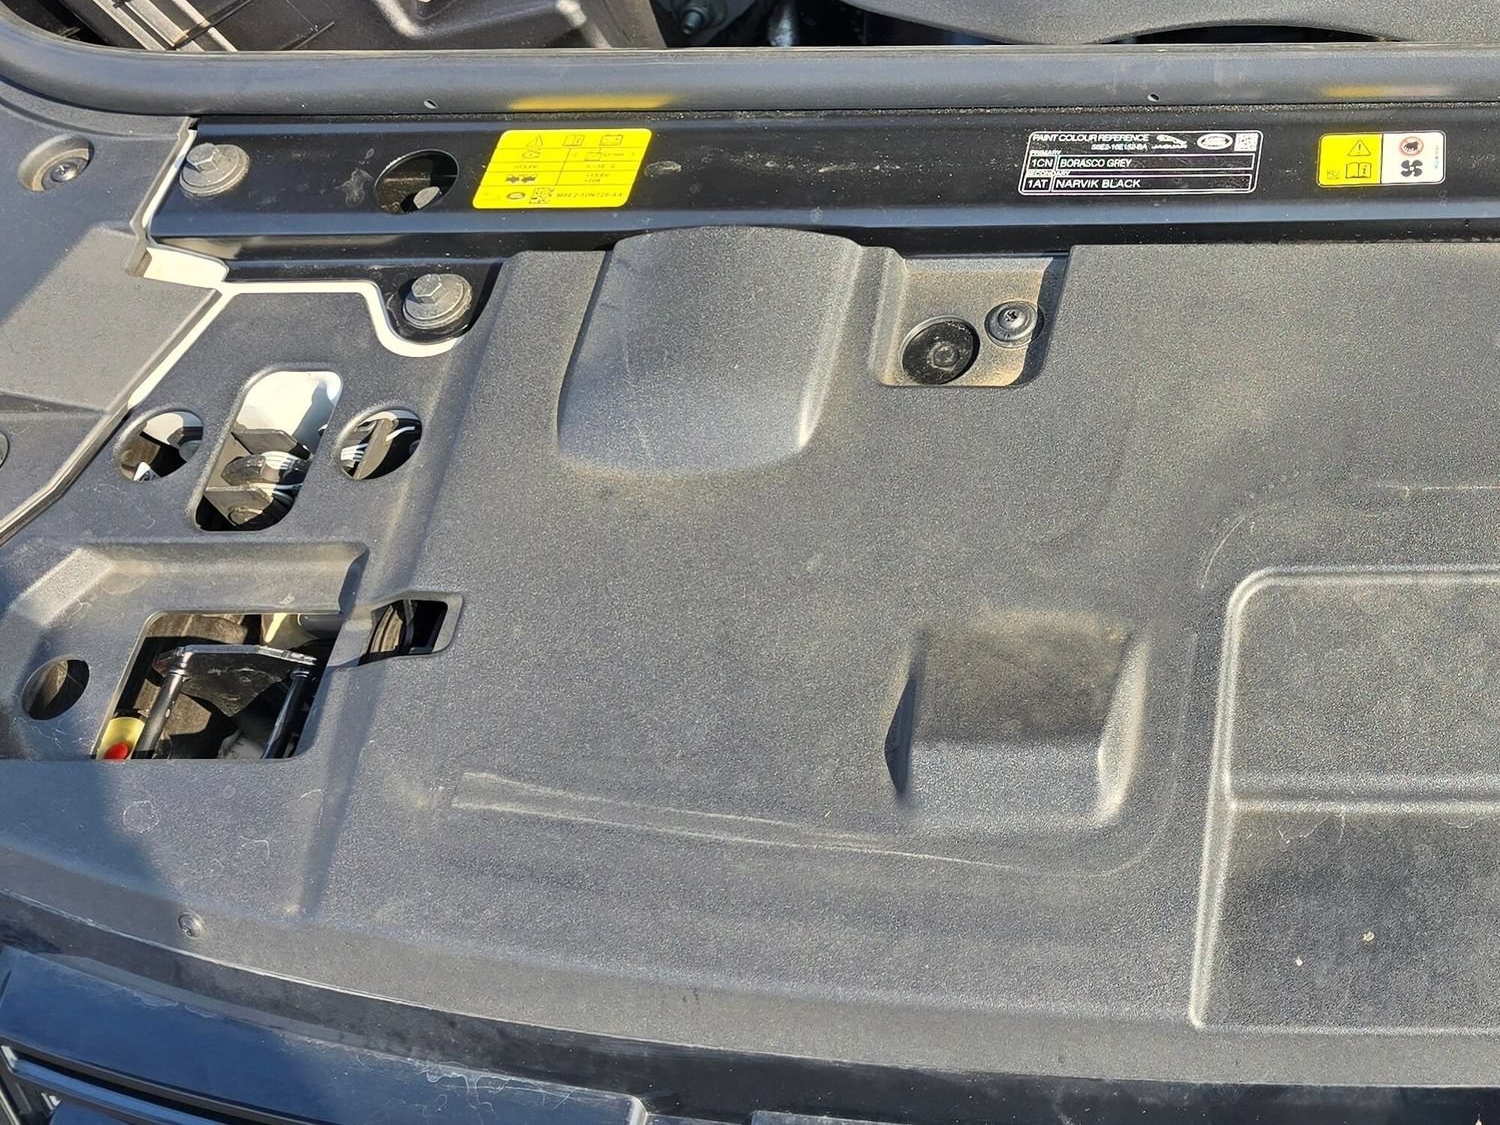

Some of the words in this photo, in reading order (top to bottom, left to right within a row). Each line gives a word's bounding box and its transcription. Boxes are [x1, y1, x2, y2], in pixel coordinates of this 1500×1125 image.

[1032, 134, 1059, 142] PAINT
[1059, 134, 1097, 142] COLOUR
[1098, 134, 1150, 142] REFERENCE
[1031, 158, 1054, 168] 1CN
[1060, 158, 1106, 168] BORASCO
[1106, 158, 1133, 168] GREY
[1028, 179, 1049, 188] 1AT
[1055, 179, 1100, 188] NARVIK
[1101, 178, 1141, 188] BLACK
